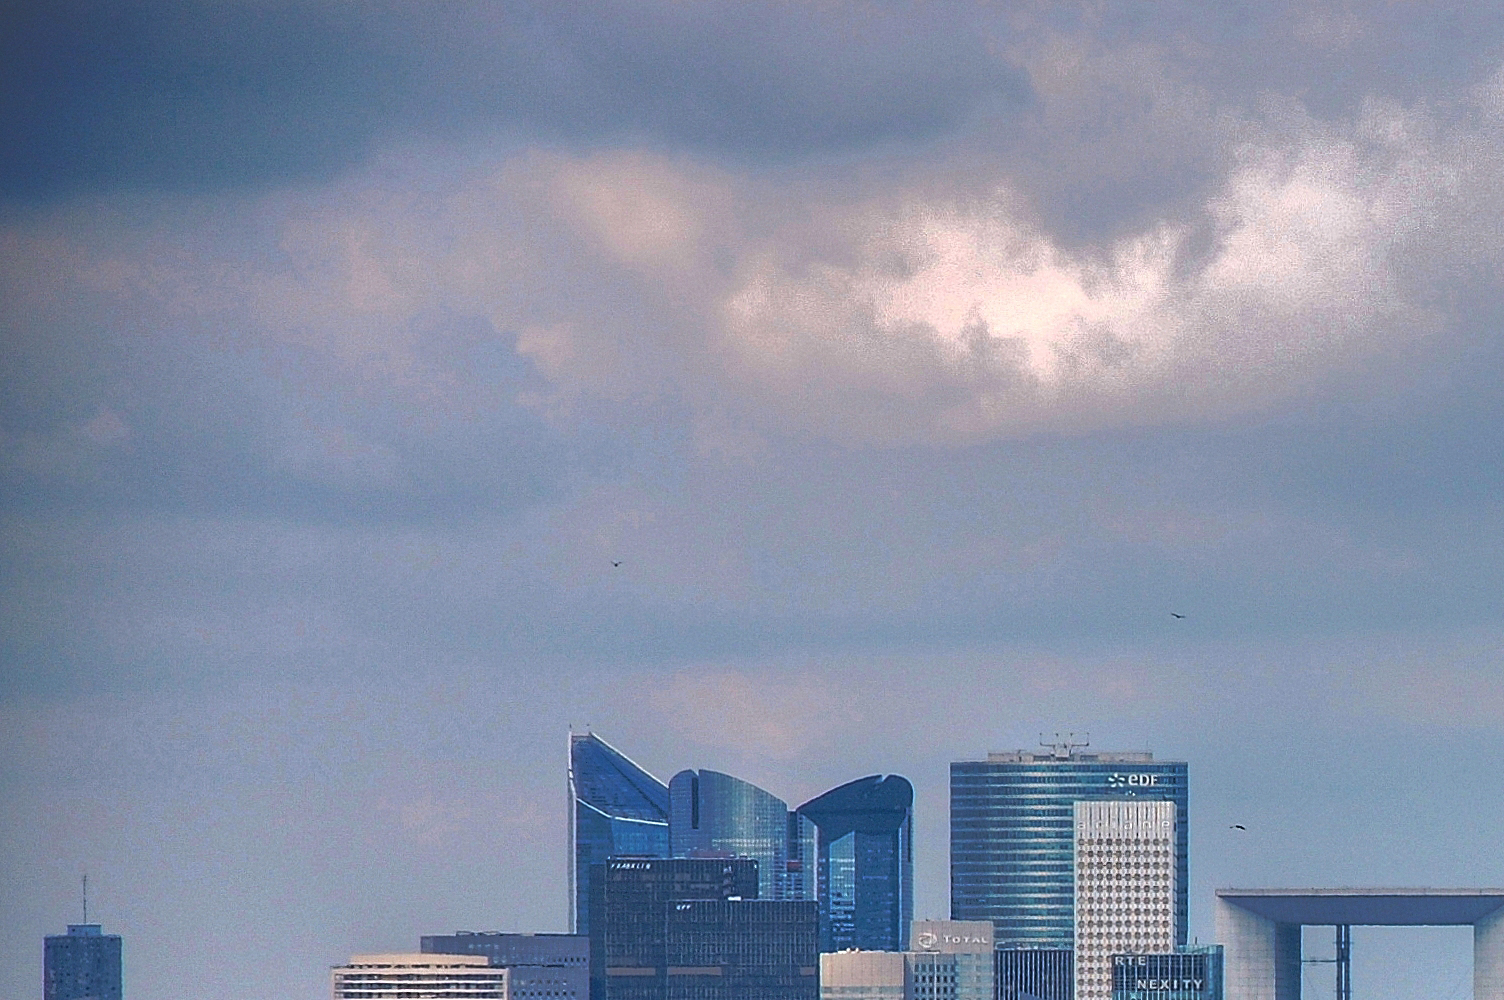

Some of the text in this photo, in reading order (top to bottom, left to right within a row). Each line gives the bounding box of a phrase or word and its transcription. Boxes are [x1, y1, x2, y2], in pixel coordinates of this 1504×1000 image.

[943, 935, 989, 944] TOTAL
[1115, 956, 1146, 966] RTE
[1137, 979, 1202, 989] NEXITY
